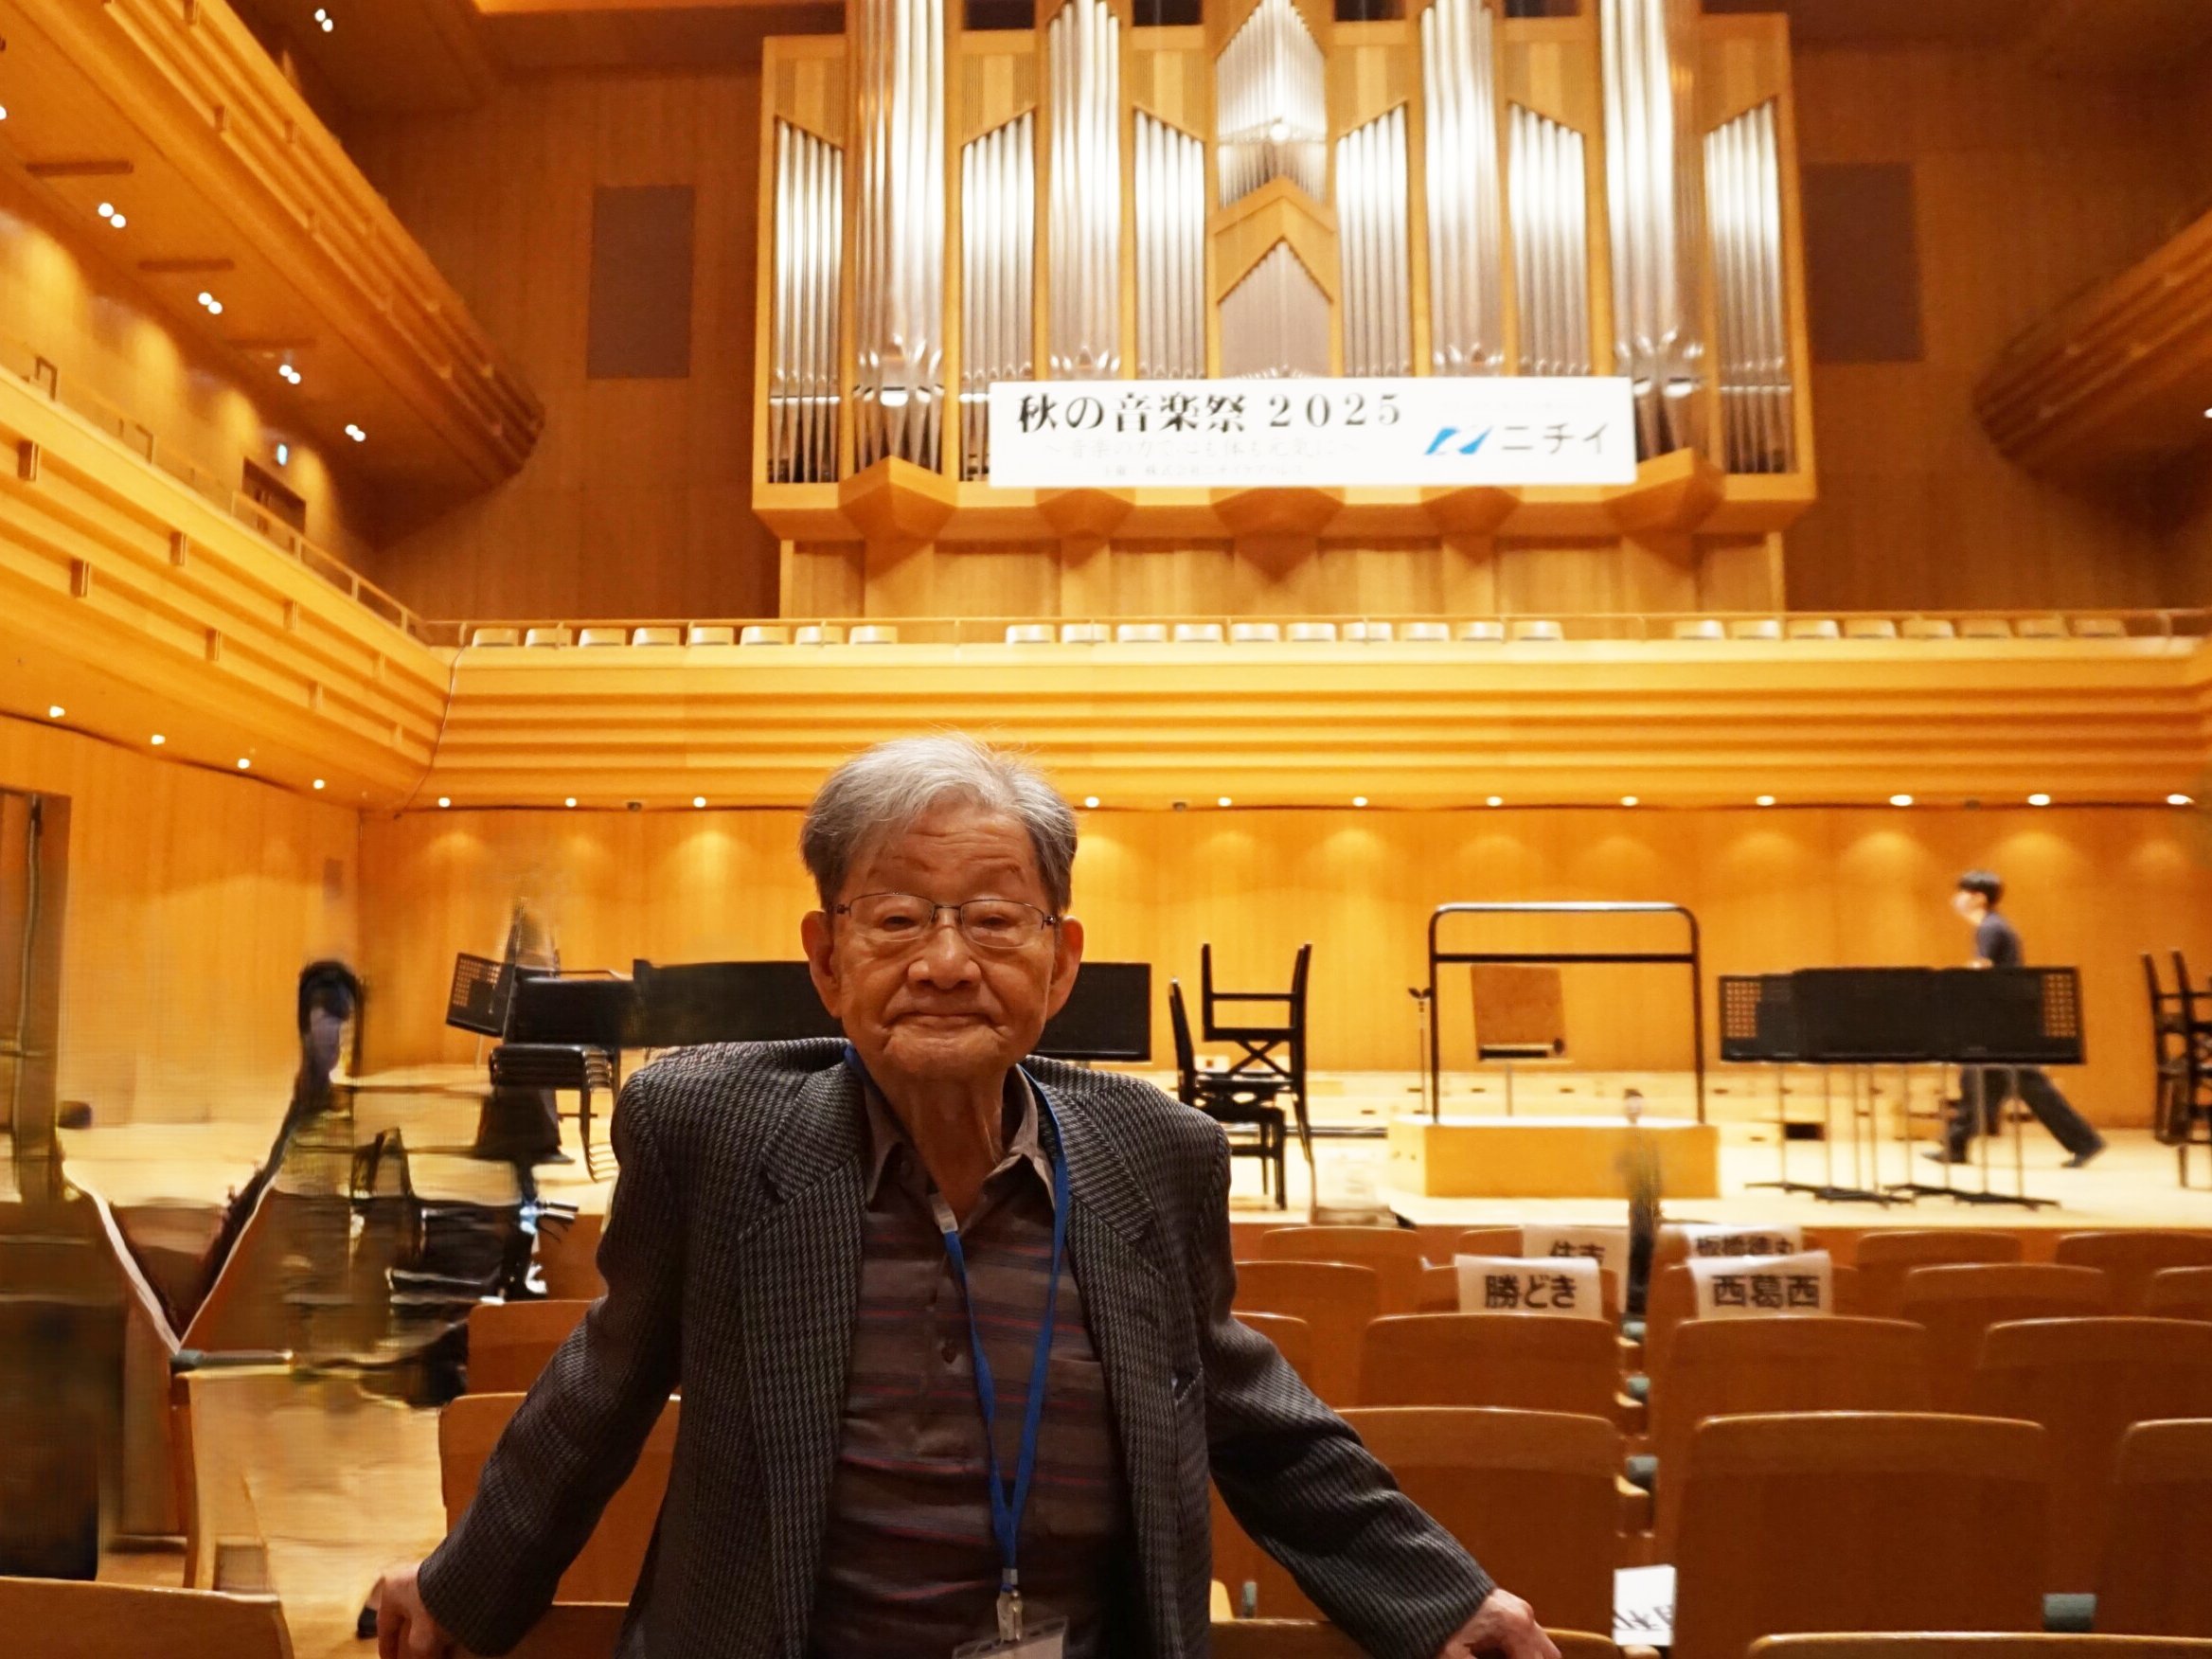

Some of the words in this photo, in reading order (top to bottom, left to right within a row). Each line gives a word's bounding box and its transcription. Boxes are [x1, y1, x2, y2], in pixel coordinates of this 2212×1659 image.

[1017, 391, 1248, 434] 秋の音楽祭
[1268, 392, 1401, 428] 2025
[1501, 421, 1611, 455] ニチイ
[1484, 1274, 1577, 1309] 勝どき
[1711, 1274, 1821, 1309] 西葛西
